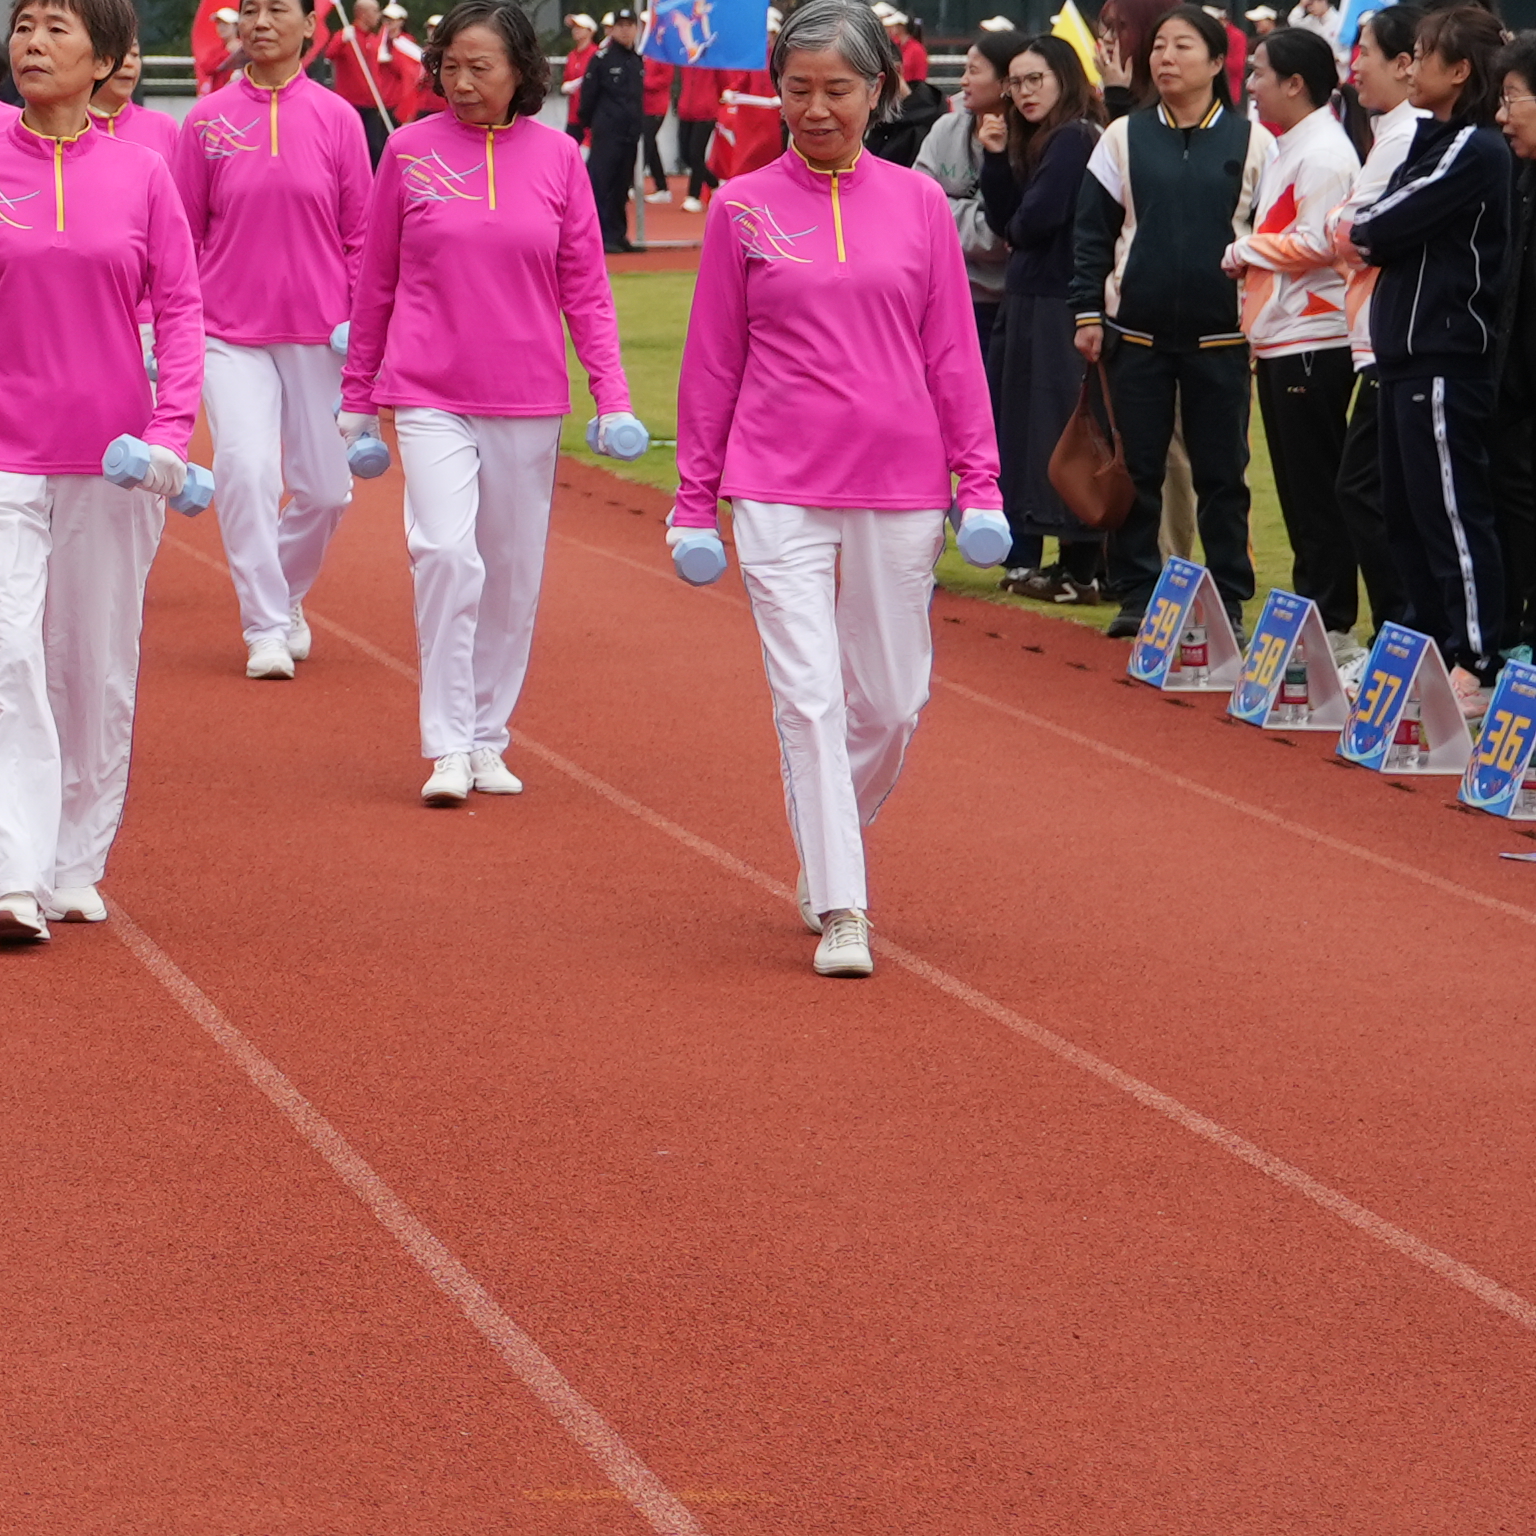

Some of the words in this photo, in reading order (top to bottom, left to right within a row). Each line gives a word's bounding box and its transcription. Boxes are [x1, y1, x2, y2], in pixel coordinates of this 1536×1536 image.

[1142, 597, 1182, 650] 39
[1244, 632, 1287, 687] 38
[1357, 669, 1403, 728] 37
[1479, 709, 1532, 772] 36
